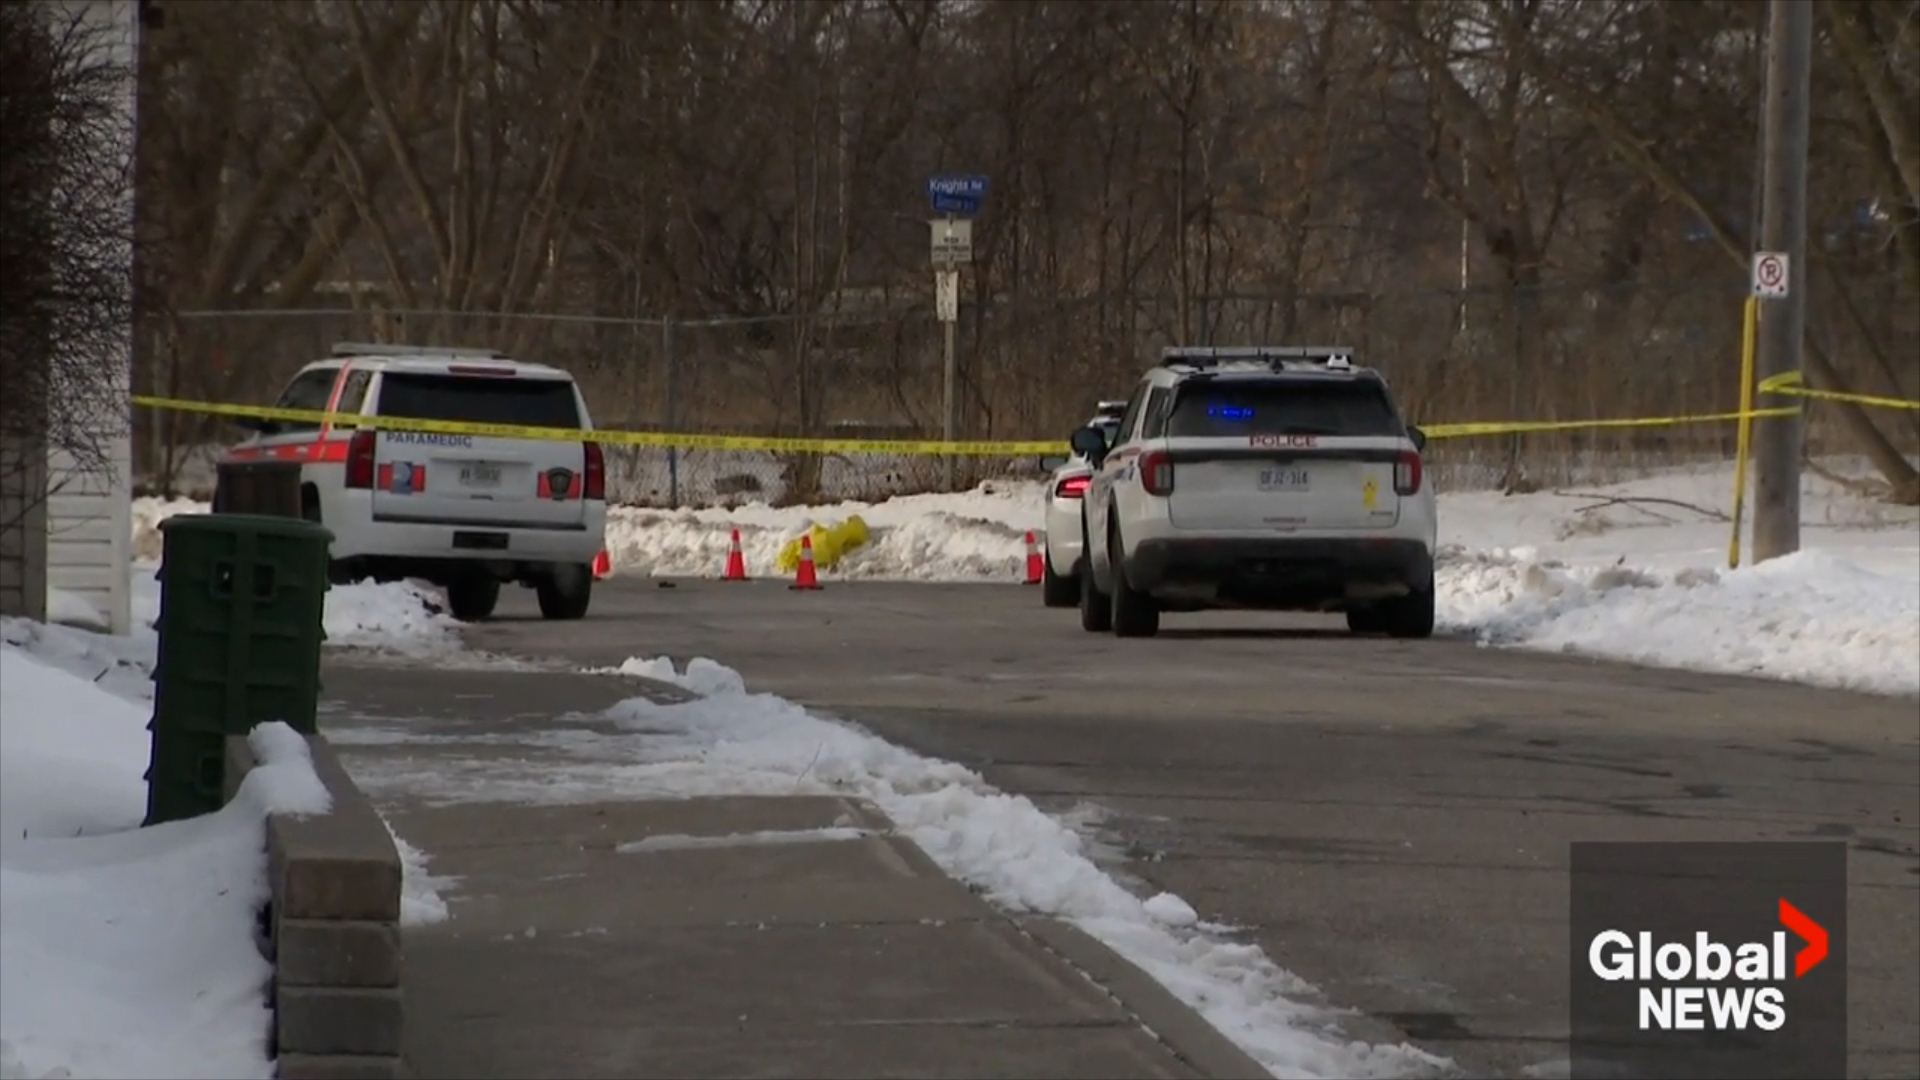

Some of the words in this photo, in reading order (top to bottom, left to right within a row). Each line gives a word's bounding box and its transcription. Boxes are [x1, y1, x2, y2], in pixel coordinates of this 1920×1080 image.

[929, 178, 968, 193] Knights
[386, 432, 473, 448] PARAMEDIC
[1249, 433, 1318, 448] POLICE
